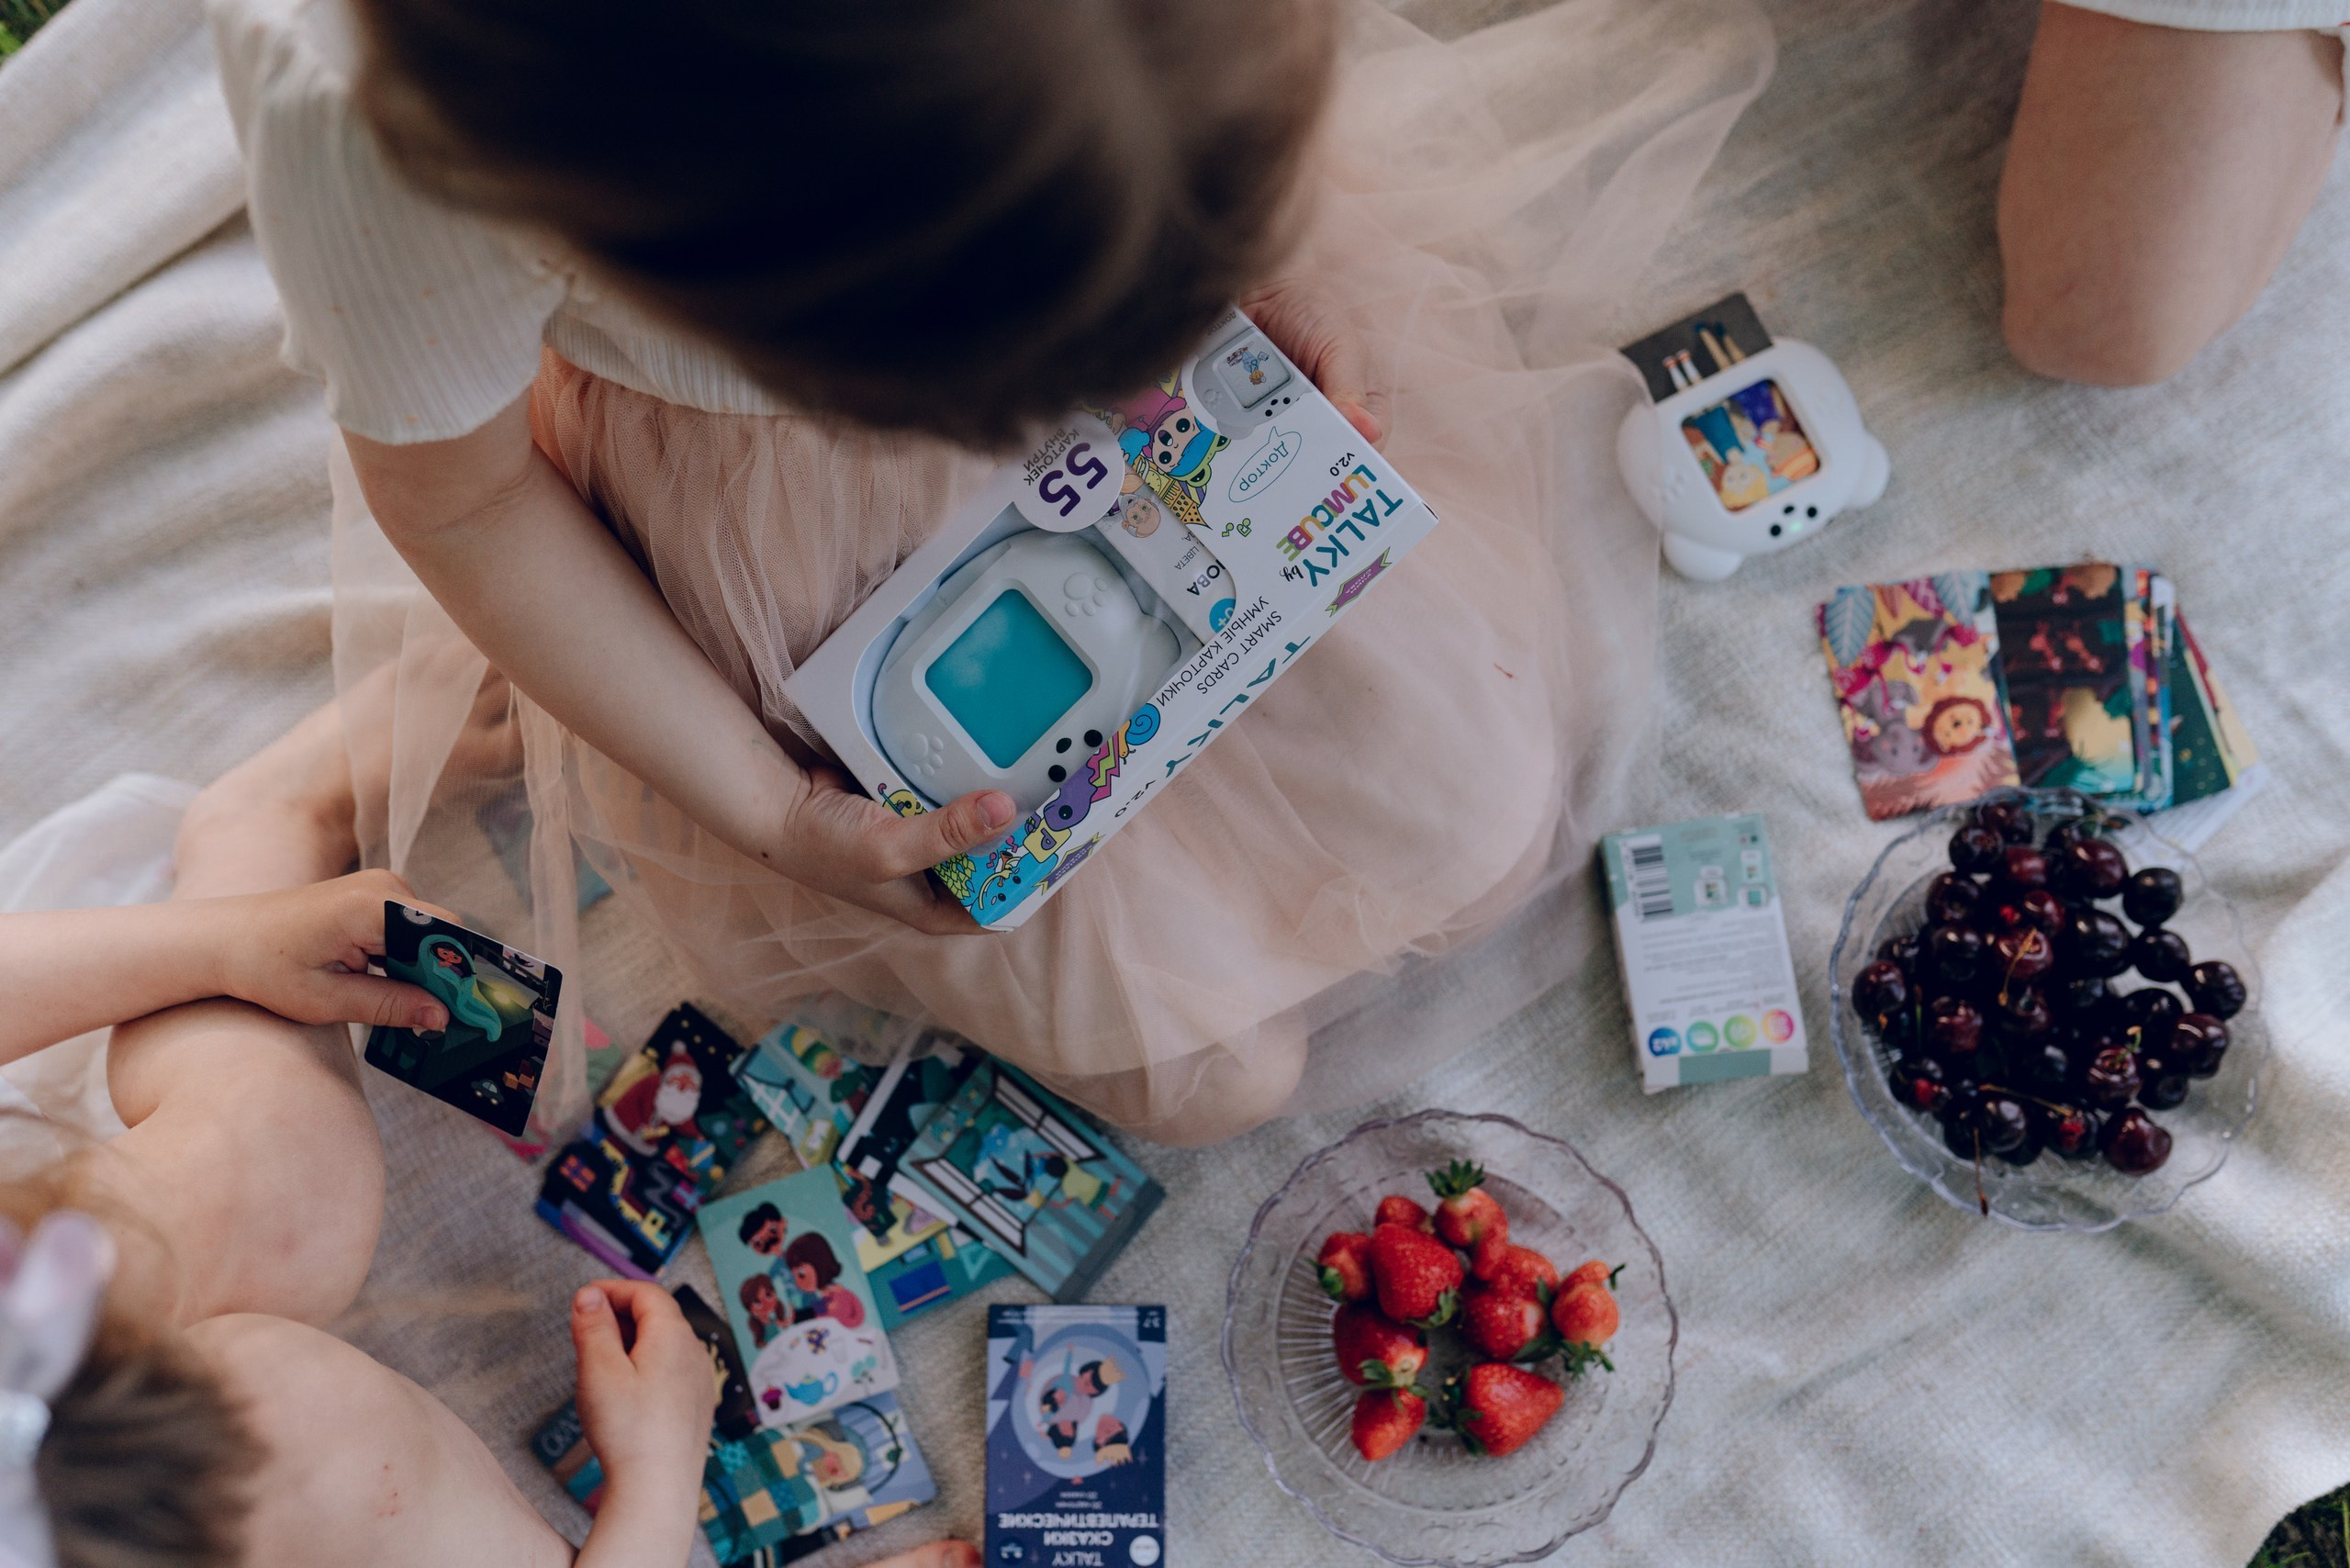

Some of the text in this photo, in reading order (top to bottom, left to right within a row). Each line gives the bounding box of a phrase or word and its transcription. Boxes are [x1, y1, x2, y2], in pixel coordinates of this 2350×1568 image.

[1023, 428, 1066, 472] ВНУТРИ
[1024, 428, 1080, 486] КАРТОЧЕК
[1239, 441, 1289, 491] Доктор
[1329, 452, 1355, 476] v2.0
[1038, 442, 1108, 517] 55
[1276, 464, 1377, 562] LUMICUBE
[1279, 488, 1404, 588] TALKY by
[1173, 545, 1200, 570] ЦВЕТА
[1344, 567, 1372, 594] СЛОВА
[1156, 596, 1270, 707] УМНЫЕ КАРТОЧКИ
[1196, 610, 1281, 695] SMART CARDS
[1114, 635, 1312, 818] TALKY v2.0
[998, 1513, 1159, 1529] ТЕРАПЕВТИЧЕСКИЕ
[1043, 1531, 1113, 1547] СКАЗКИ
[1052, 1551, 1104, 1567] TALKY
